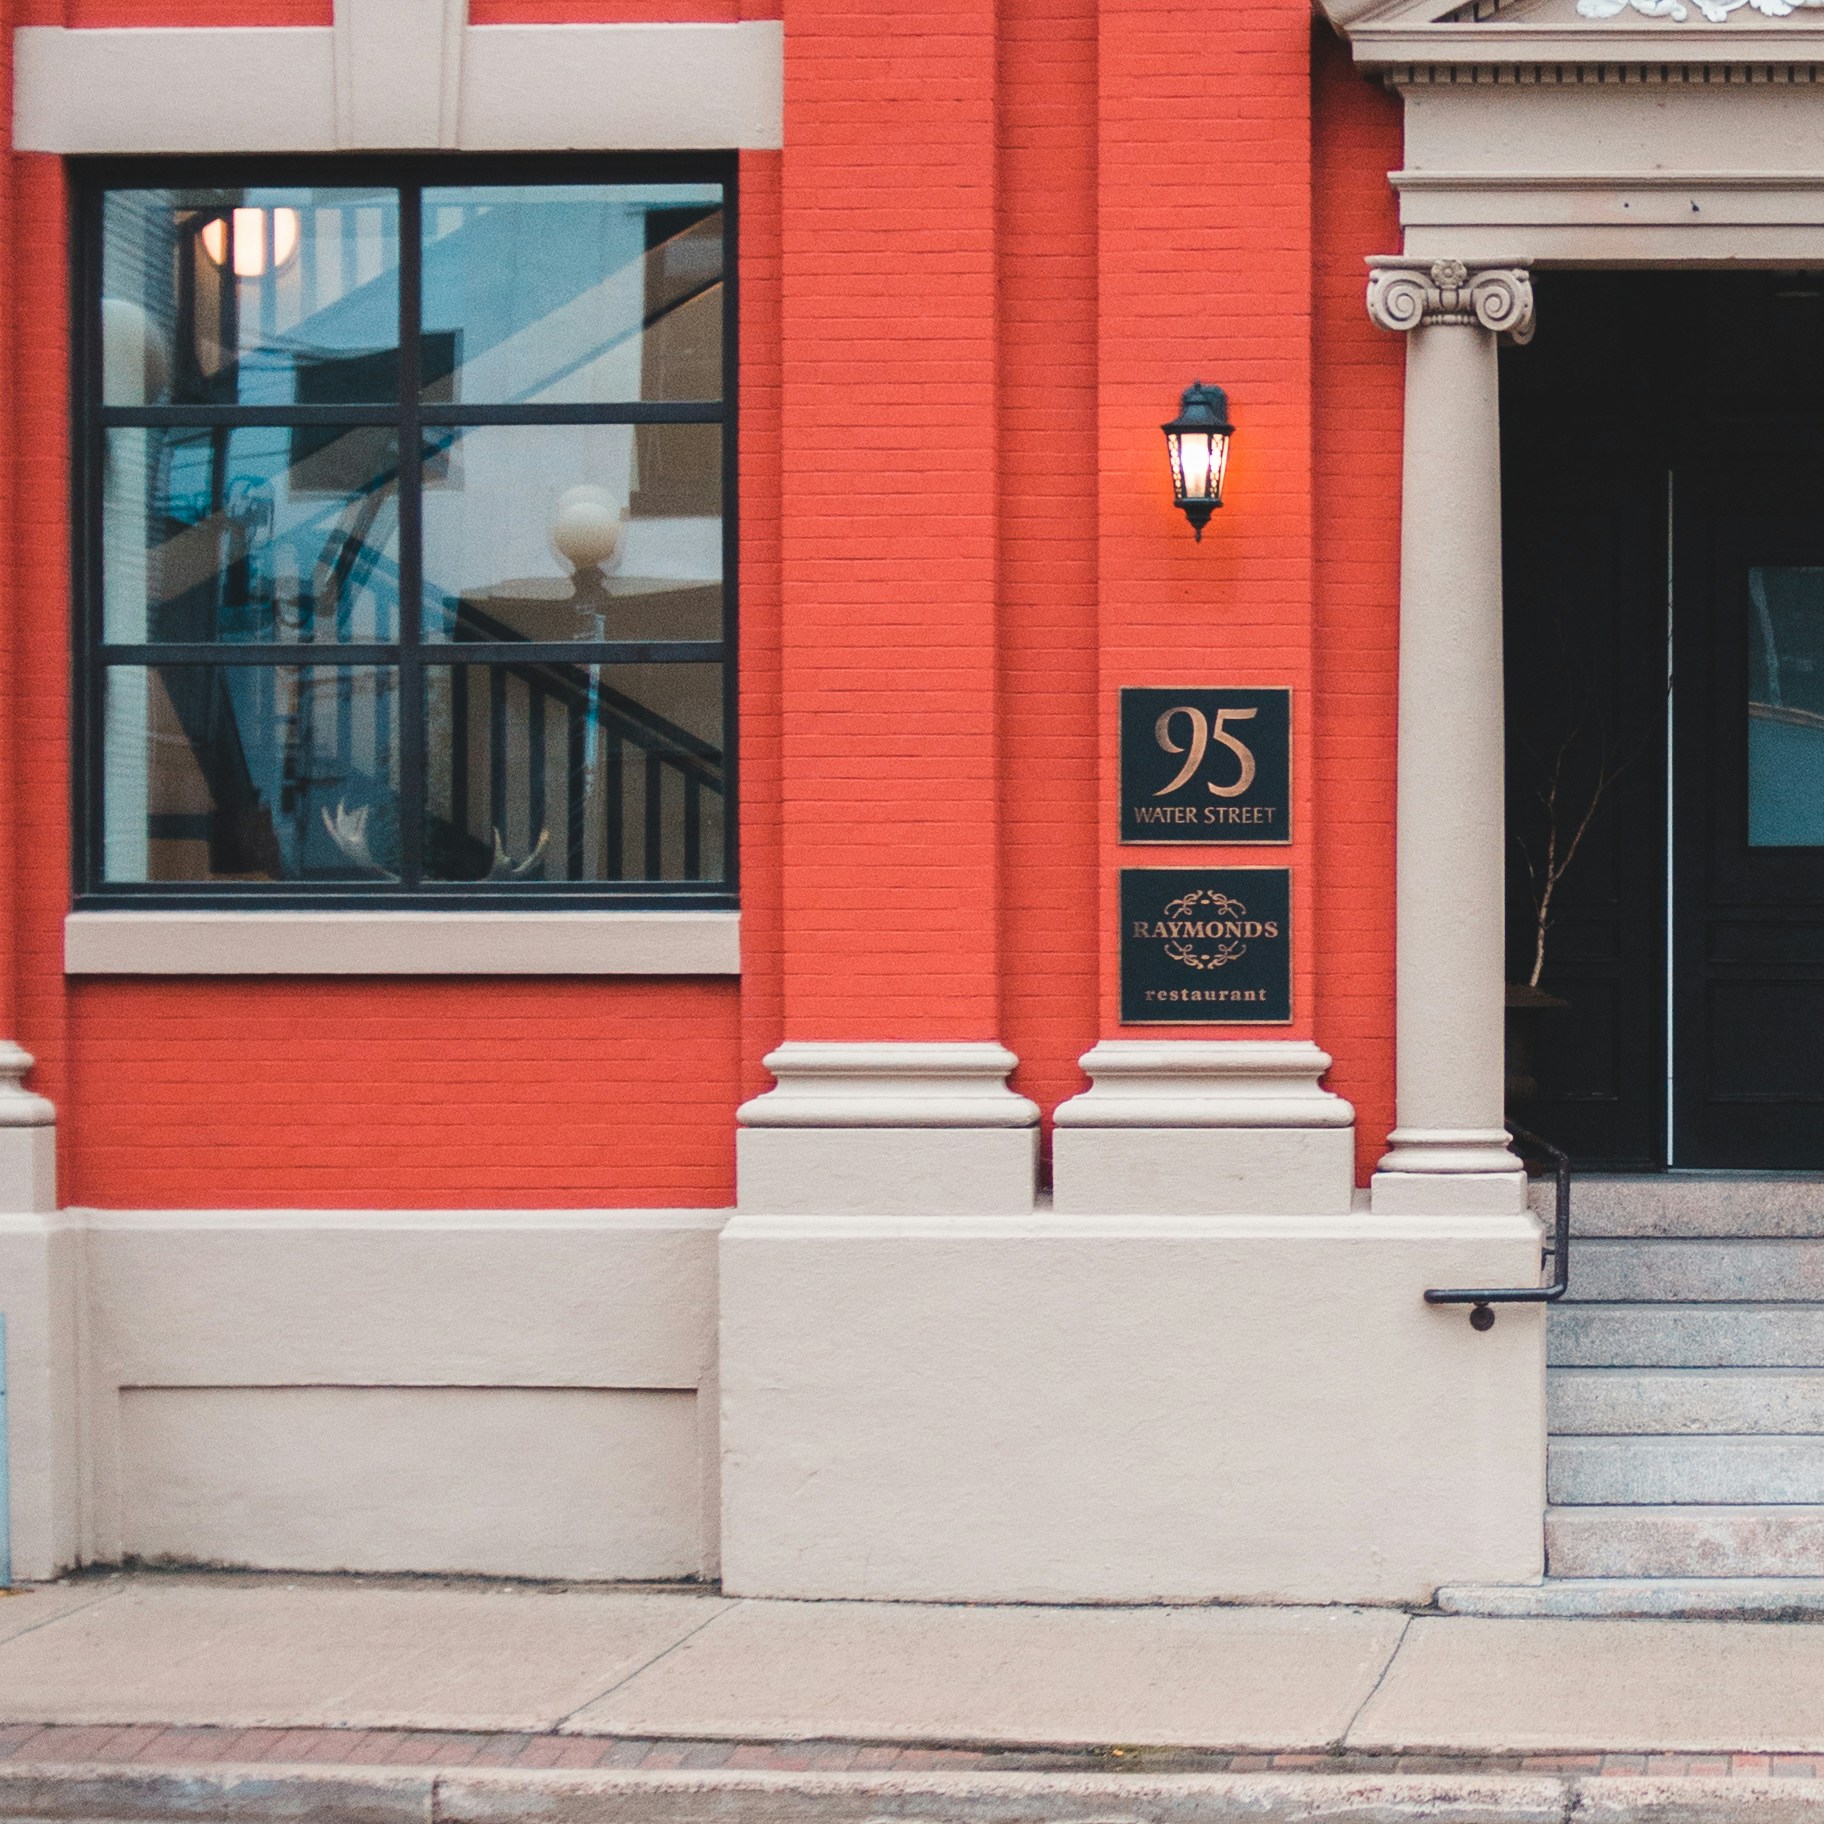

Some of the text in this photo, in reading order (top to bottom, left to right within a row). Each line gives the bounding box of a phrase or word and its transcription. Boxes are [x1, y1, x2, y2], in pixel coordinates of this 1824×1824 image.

[1153, 706, 1259, 799] 95
[1134, 807, 1277, 825] WATER STREET
[1133, 921, 1280, 939] RAYMONDS
[1145, 988, 1268, 1003] restaurant
